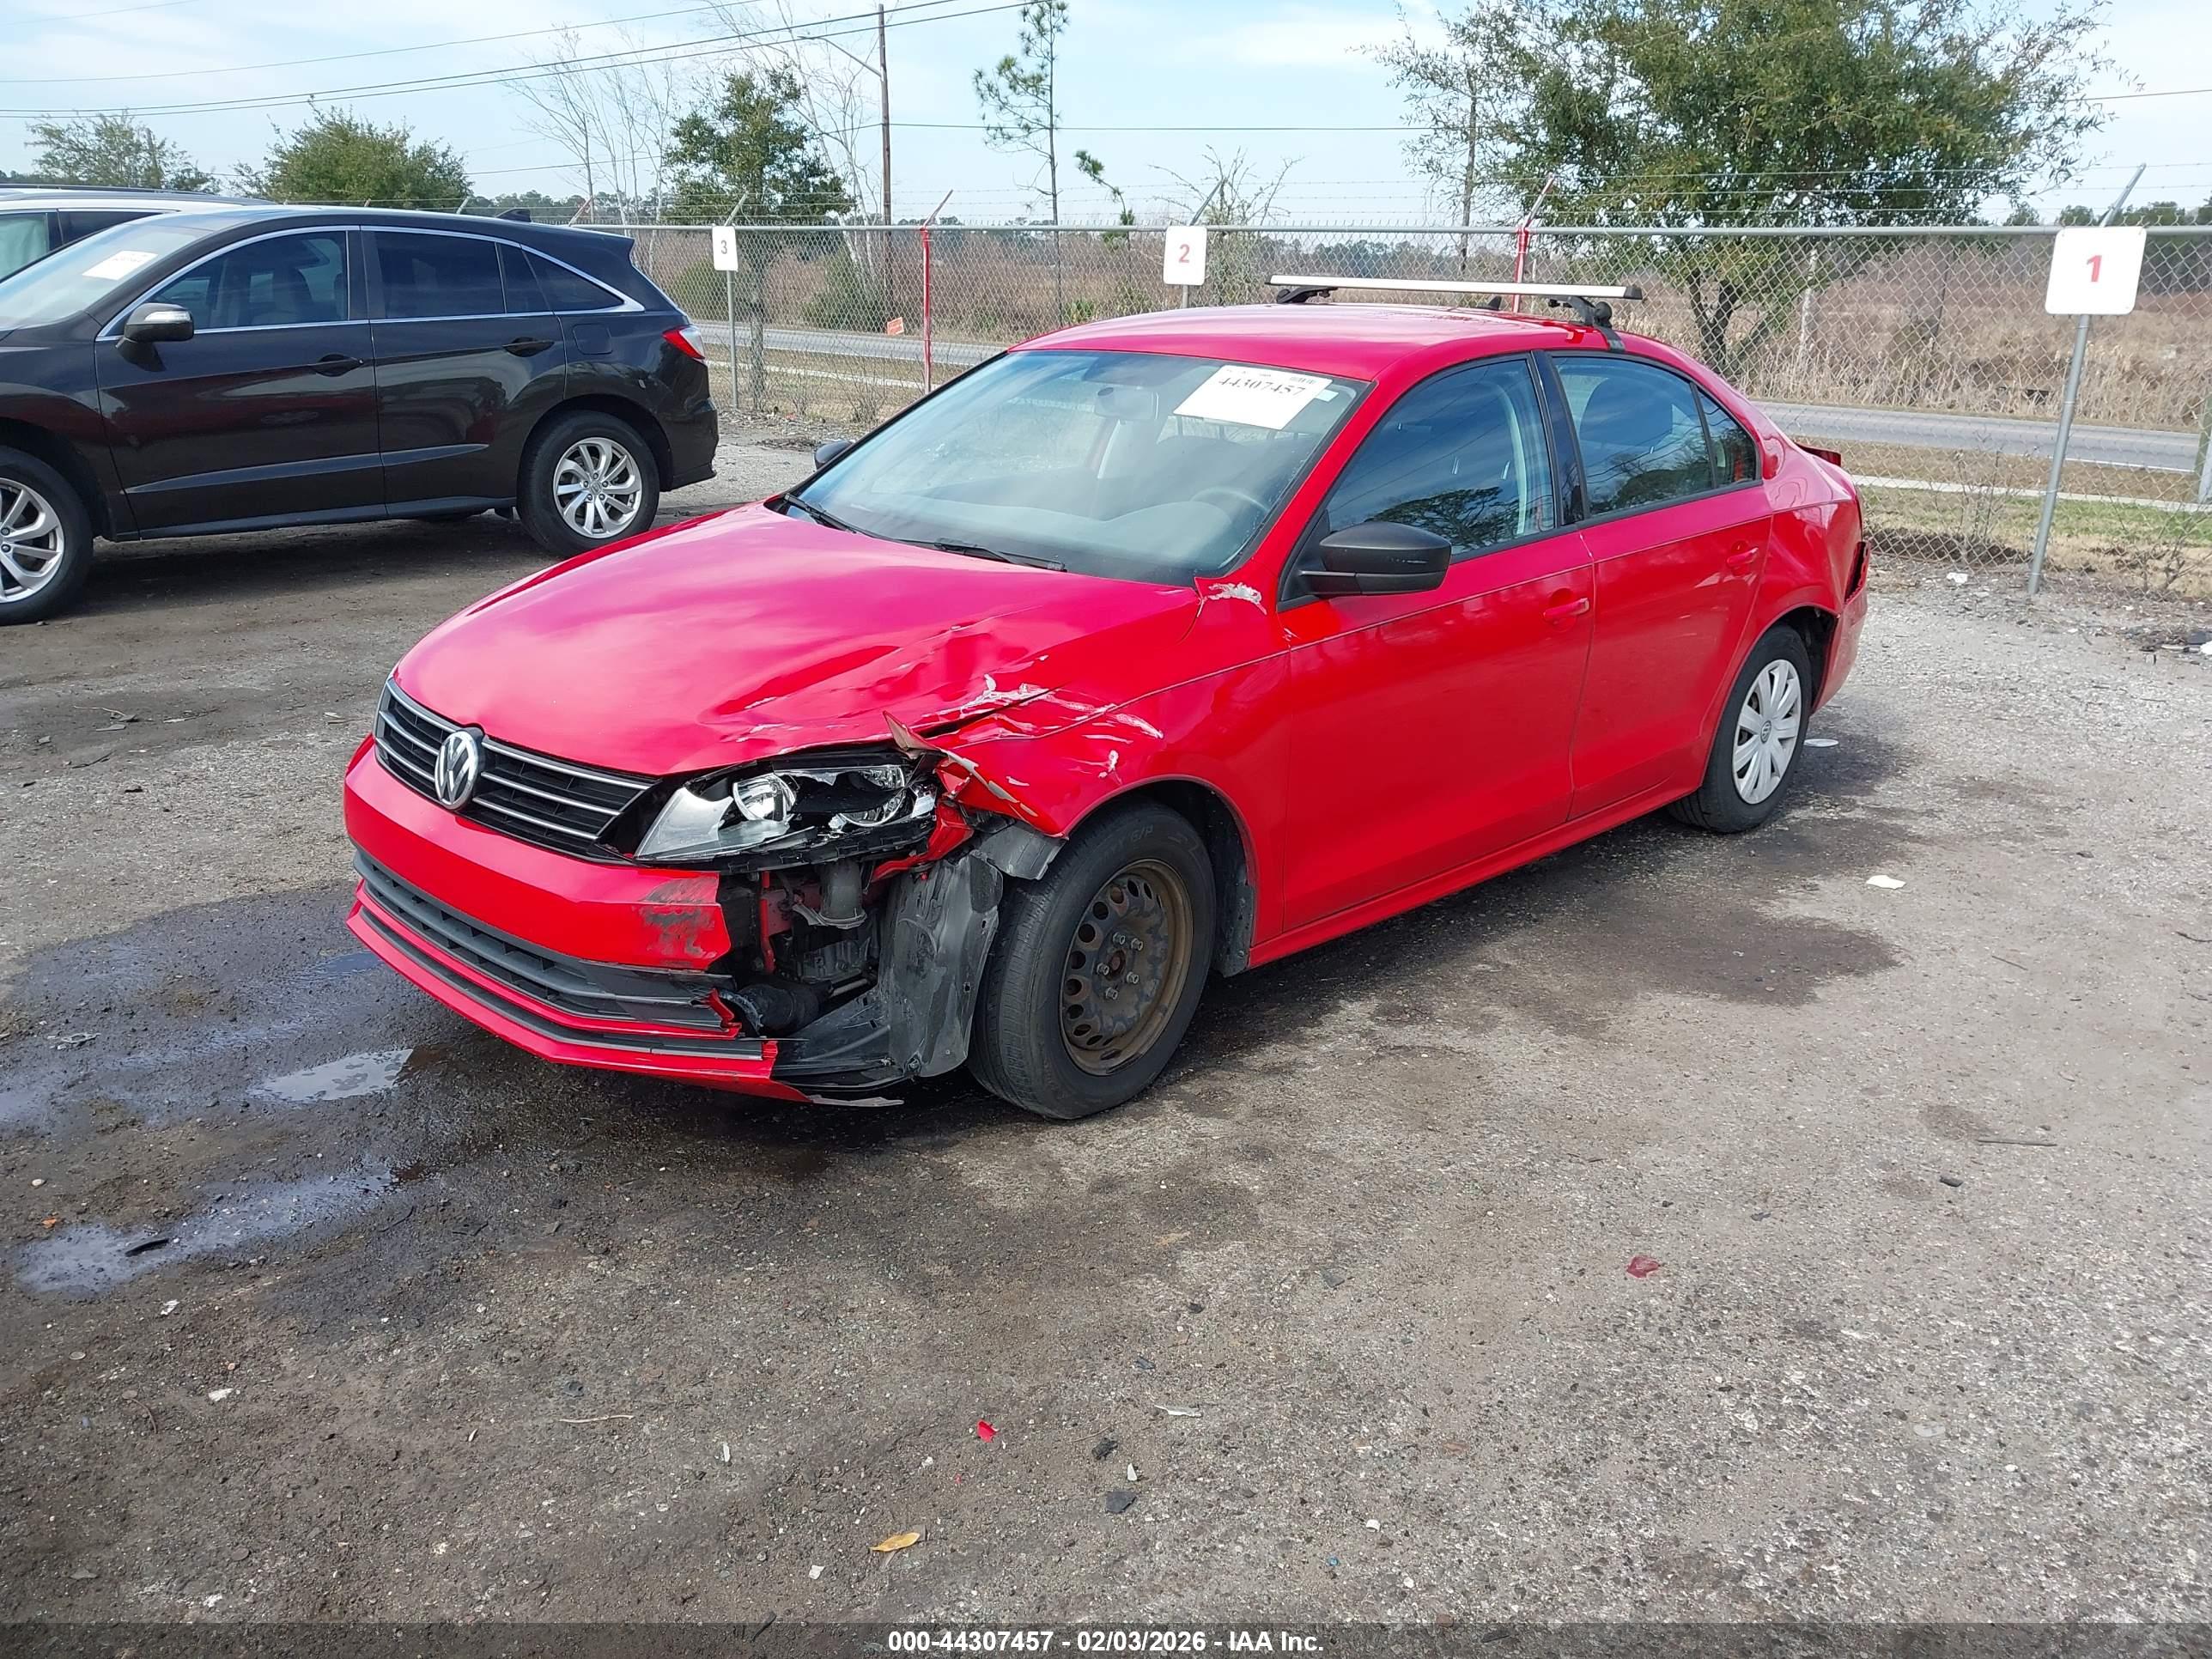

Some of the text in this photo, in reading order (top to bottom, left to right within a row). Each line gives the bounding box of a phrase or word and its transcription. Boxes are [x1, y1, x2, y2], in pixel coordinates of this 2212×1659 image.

[720, 240, 728, 255] 3
[1179, 243, 1190, 264] 2
[2086, 254, 2103, 283] 1
